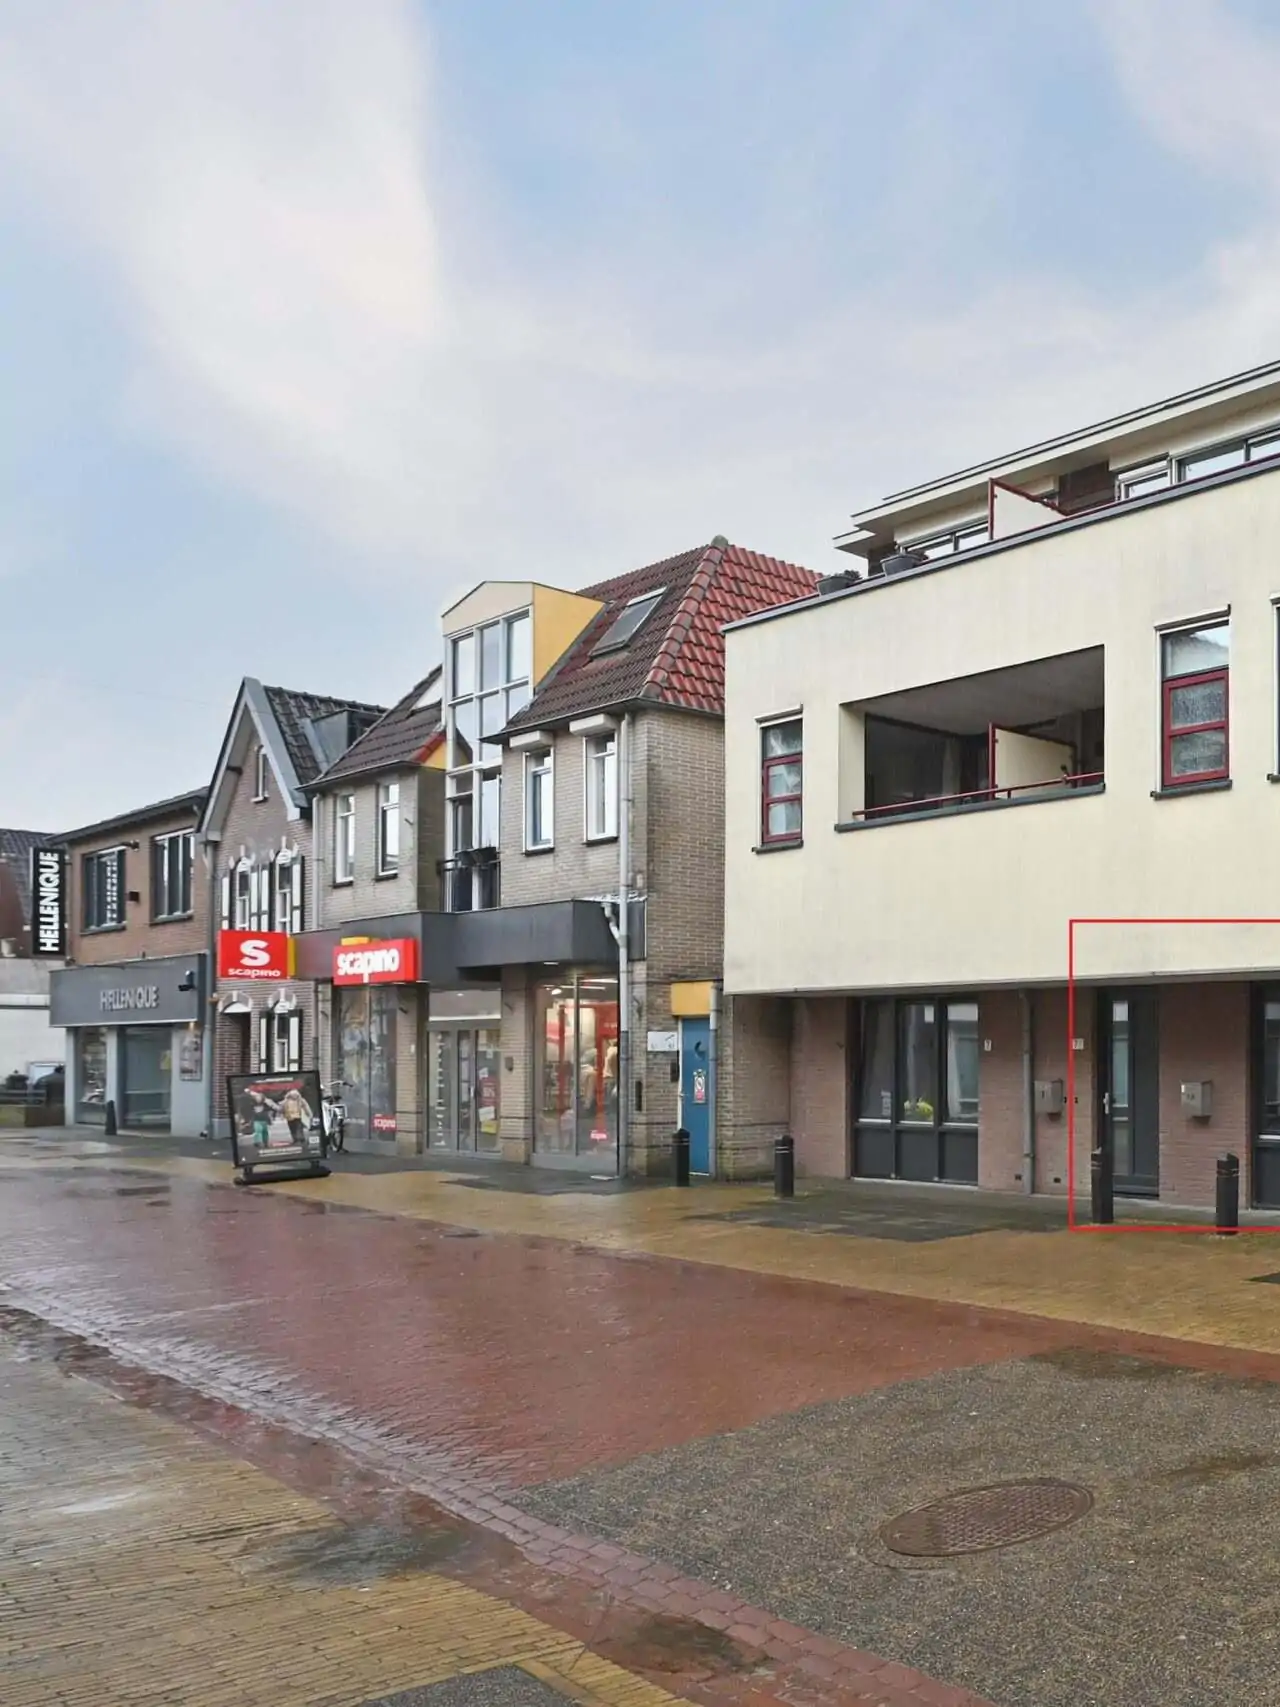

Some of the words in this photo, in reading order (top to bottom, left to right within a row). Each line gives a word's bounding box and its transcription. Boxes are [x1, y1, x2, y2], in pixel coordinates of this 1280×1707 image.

[39, 851, 60, 952] HELLENIQUE
[239, 939, 271, 967] S
[337, 948, 400, 983] scapino
[228, 967, 281, 978] scapino
[100, 985, 159, 1011] HELLENIQUE
